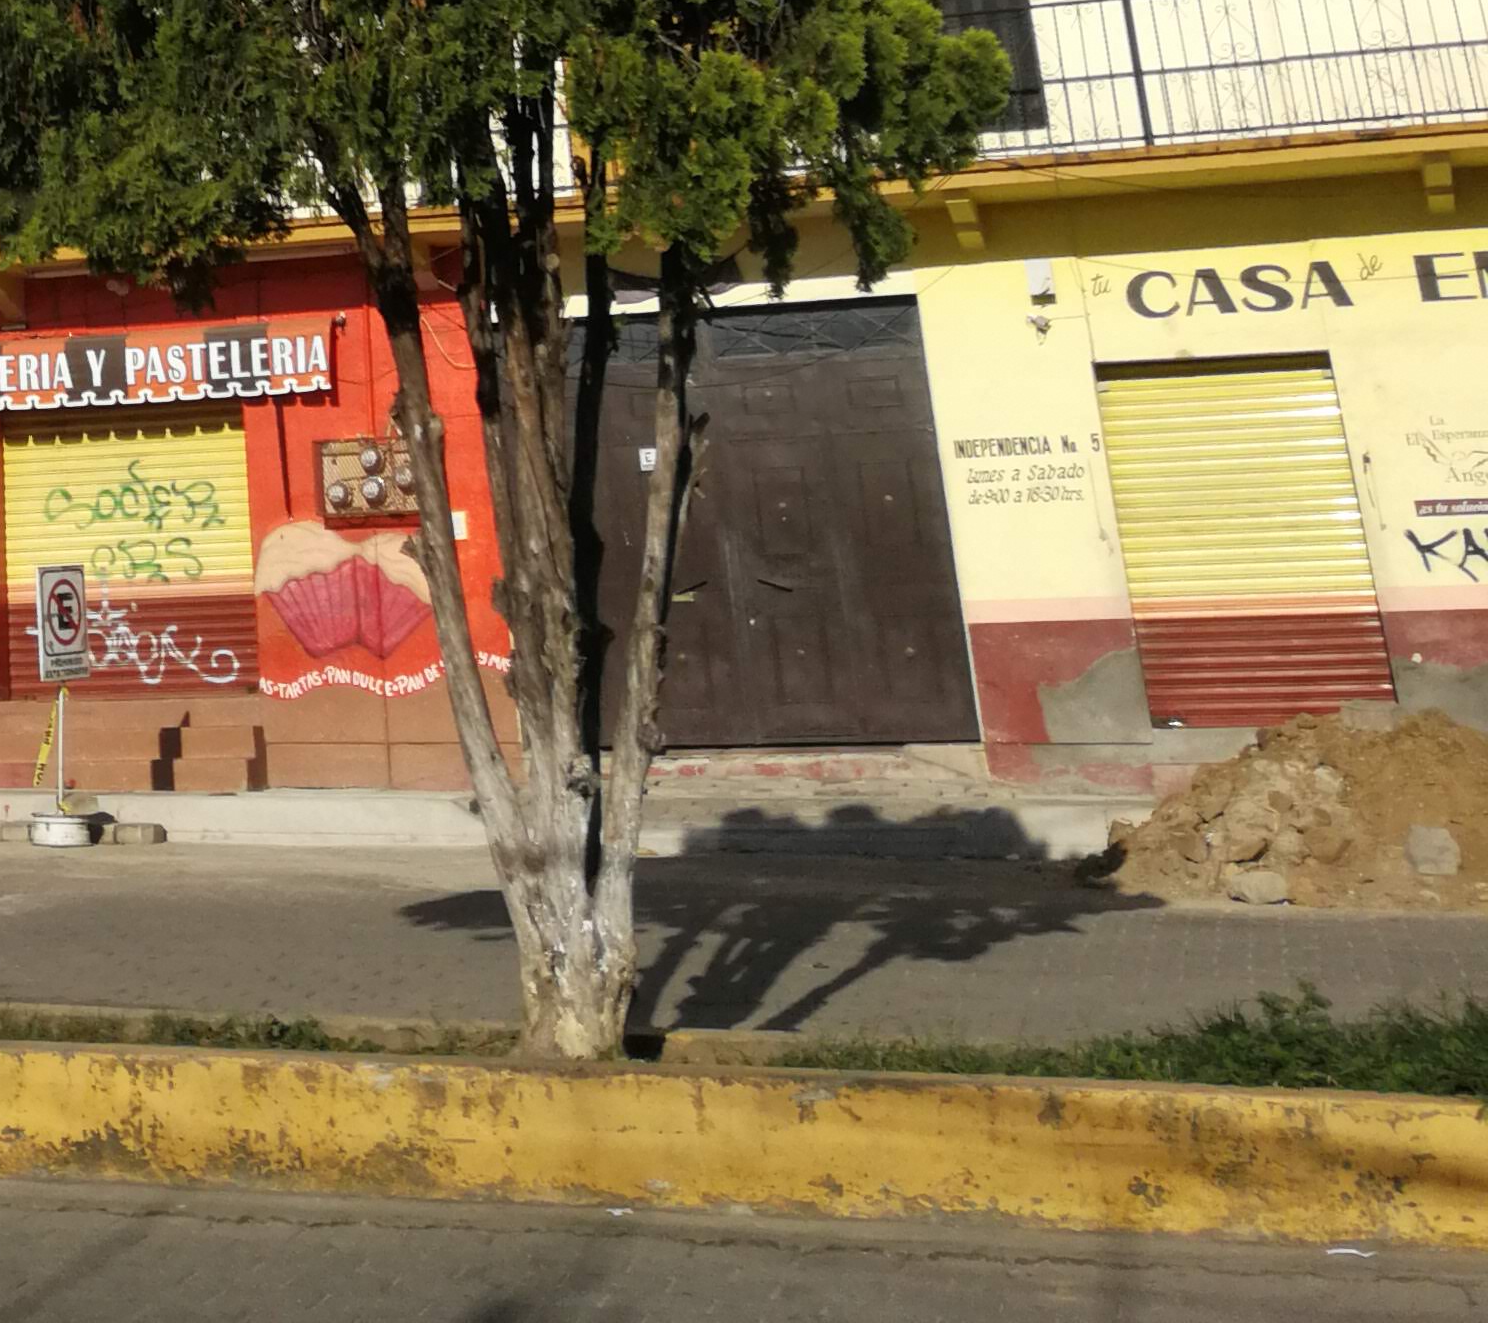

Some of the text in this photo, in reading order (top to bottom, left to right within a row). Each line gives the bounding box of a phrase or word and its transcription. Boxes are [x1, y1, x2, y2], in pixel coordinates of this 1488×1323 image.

[1091, 250, 1488, 319] tu CASA de E
[85, 348, 107, 388] Y
[124, 334, 330, 386] PASTELERIA
[953, 436, 1053, 459] INDEPENDENCIA
[1090, 432, 1101, 453] 5
[966, 463, 1085, 484] Lunes a Sabado
[1013, 490, 1022, 503] a
[56, 591, 74, 631] E
